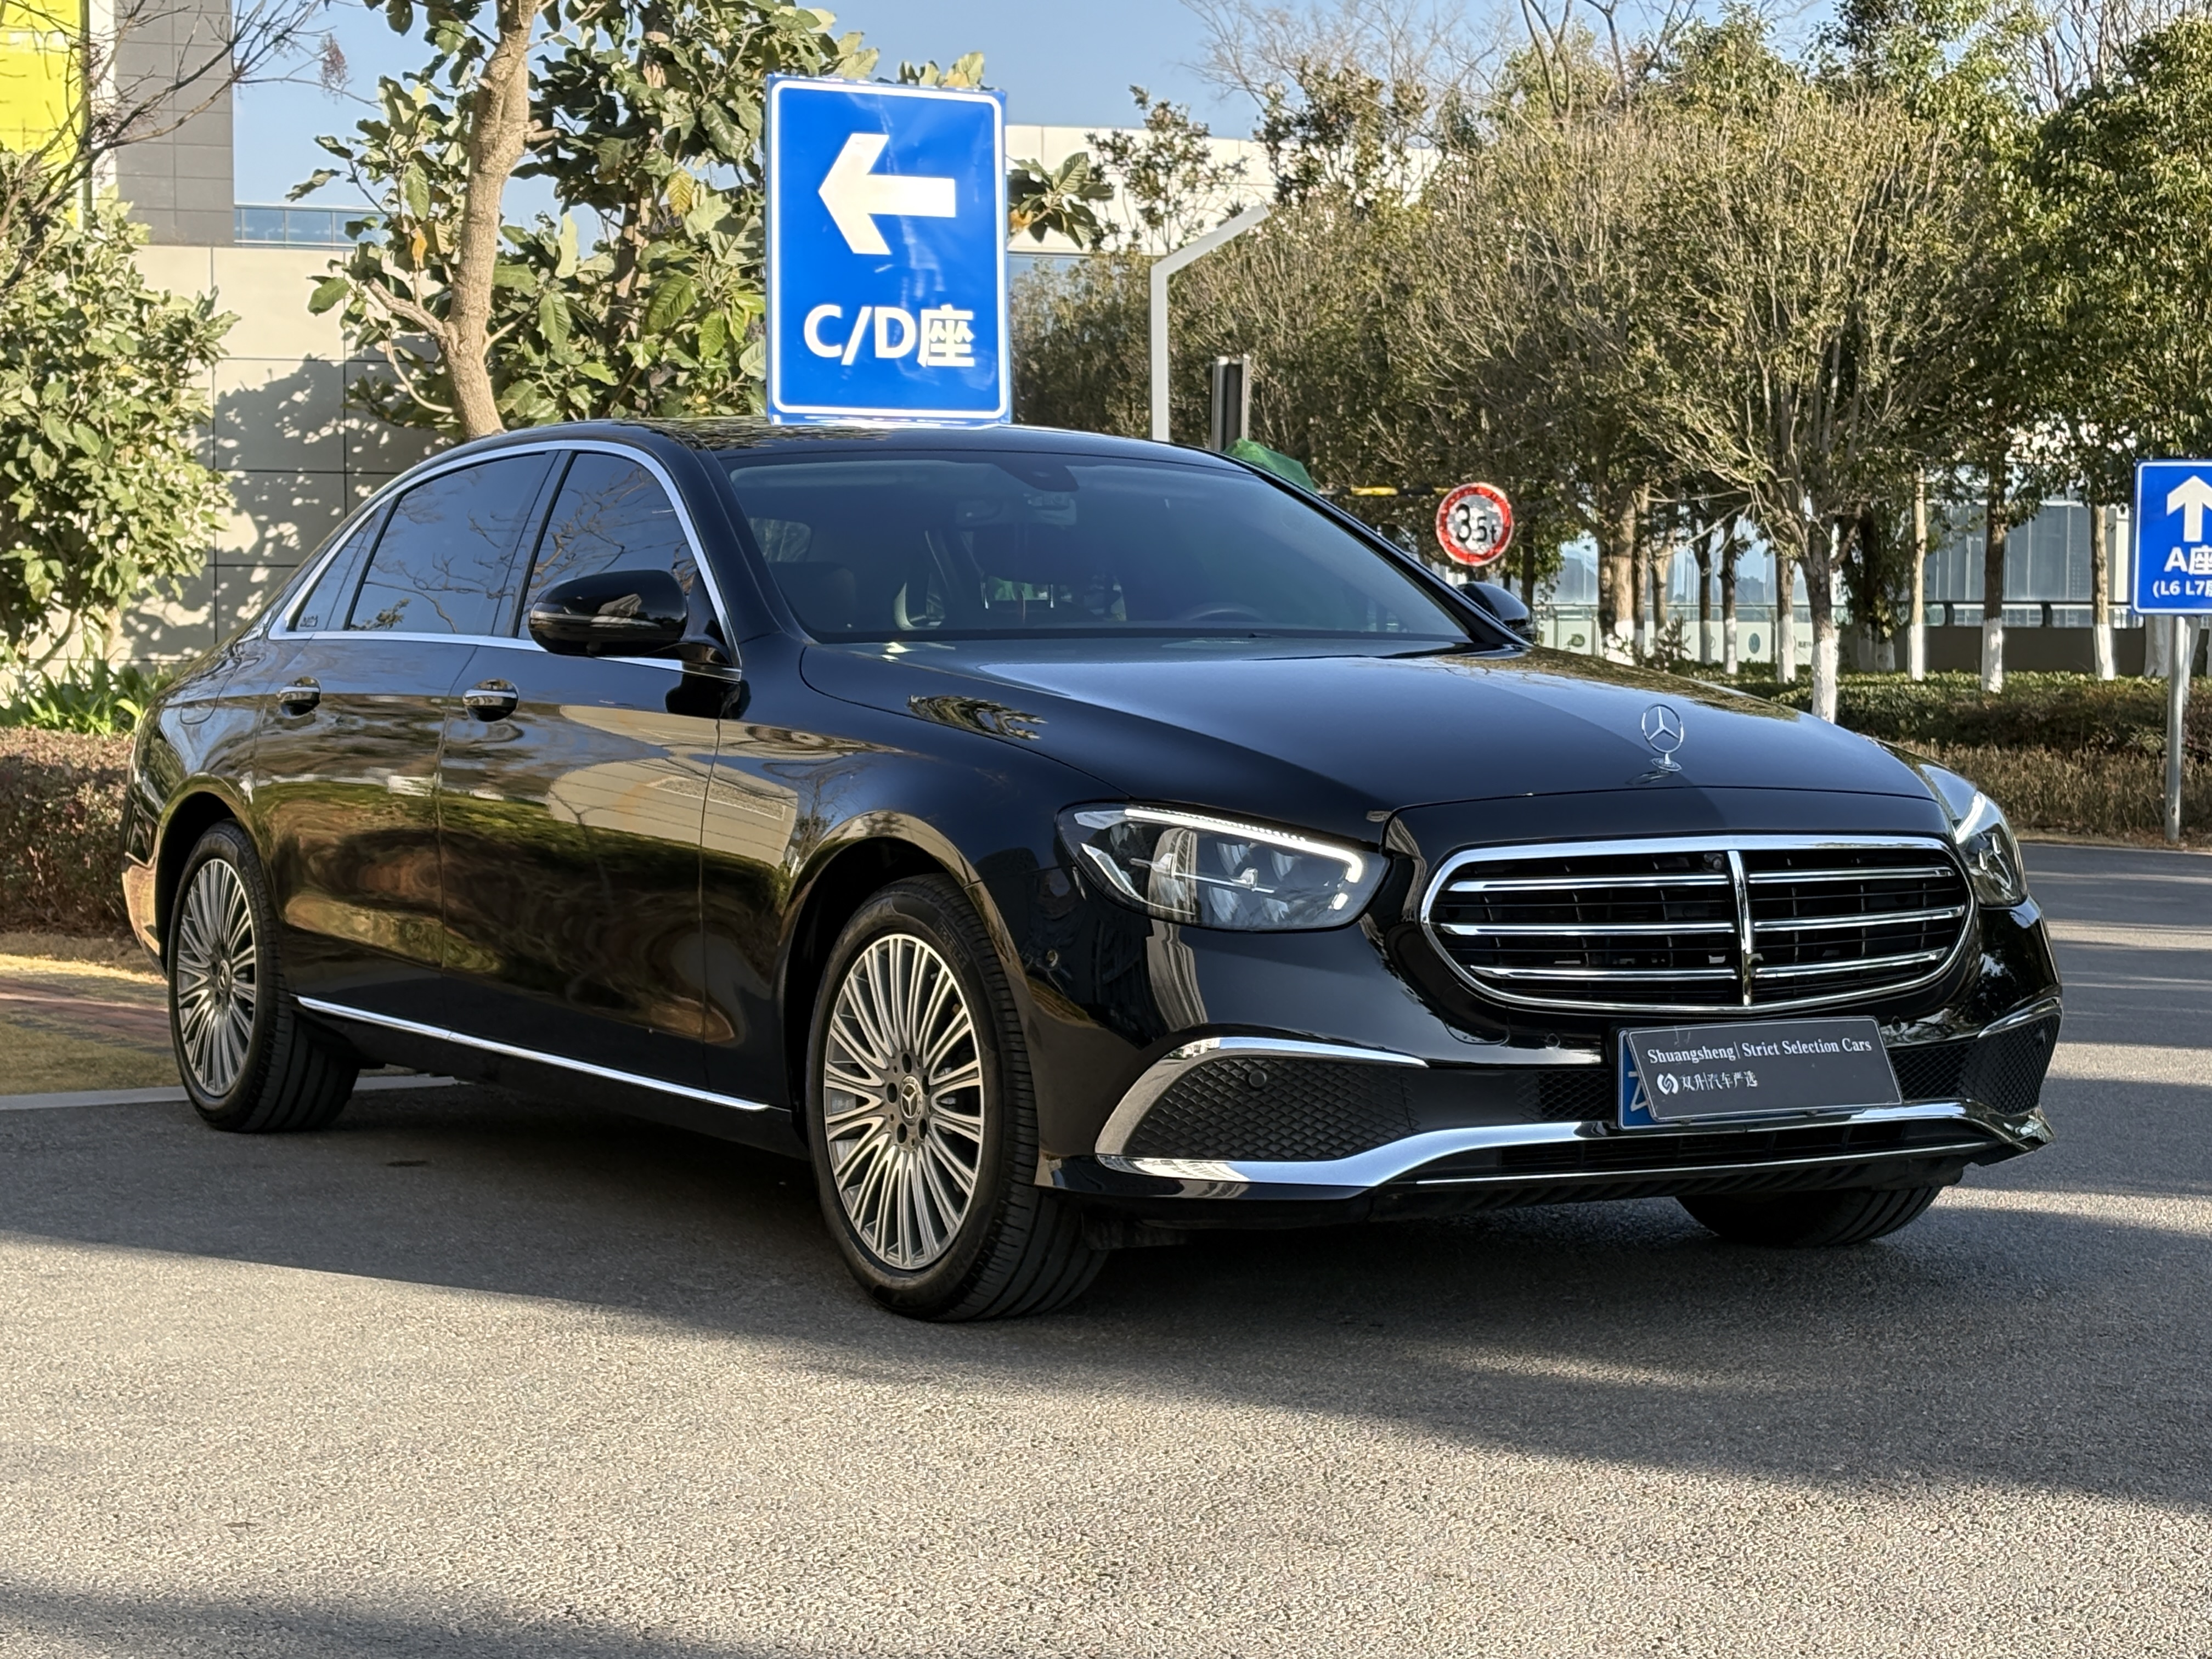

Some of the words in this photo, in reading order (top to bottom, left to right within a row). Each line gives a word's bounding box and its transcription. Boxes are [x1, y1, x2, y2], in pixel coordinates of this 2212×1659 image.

[804, 303, 975, 368] C/D座
[2153, 580, 2180, 599] (L6
[1742, 1041, 1781, 1057] Strict
[1782, 1039, 1840, 1054] Selection
[1842, 1037, 1872, 1052] Cars
